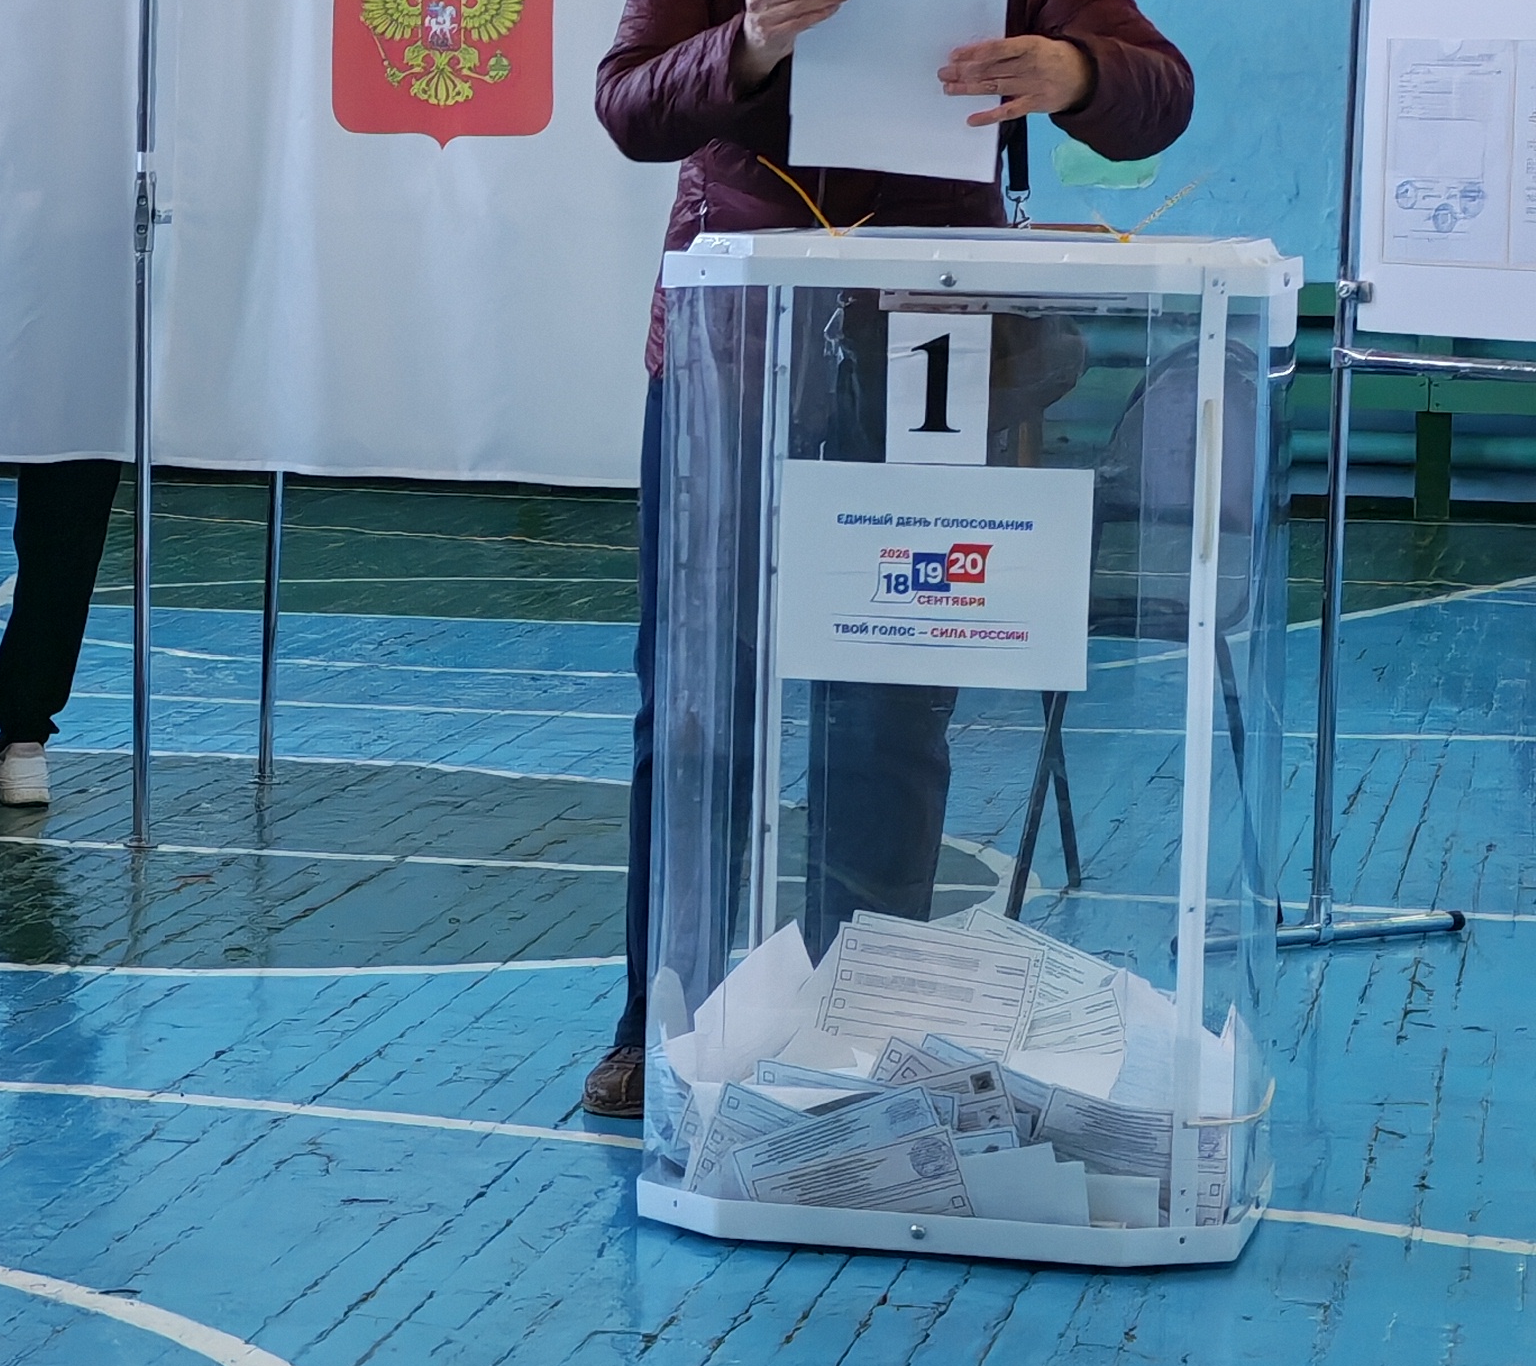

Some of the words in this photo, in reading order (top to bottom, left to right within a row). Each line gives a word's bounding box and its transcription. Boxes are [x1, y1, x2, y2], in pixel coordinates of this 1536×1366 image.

[908, 333, 961, 433] 1
[837, 513, 893, 526] ЕДИНЫЙ
[895, 516, 931, 528] ДЕНЬ
[934, 517, 1033, 531] ГОЛОСОВАНИЯ
[880, 548, 910, 558] 2026
[882, 573, 910, 595] 18
[915, 561, 943, 584] 19
[948, 552, 983, 575] 20
[917, 595, 986, 607] СЕНТЯБРЯ
[833, 622, 869, 635] ТВОЙ
[871, 625, 915, 637] ГОЛОС
[930, 627, 967, 639] СИЛА
